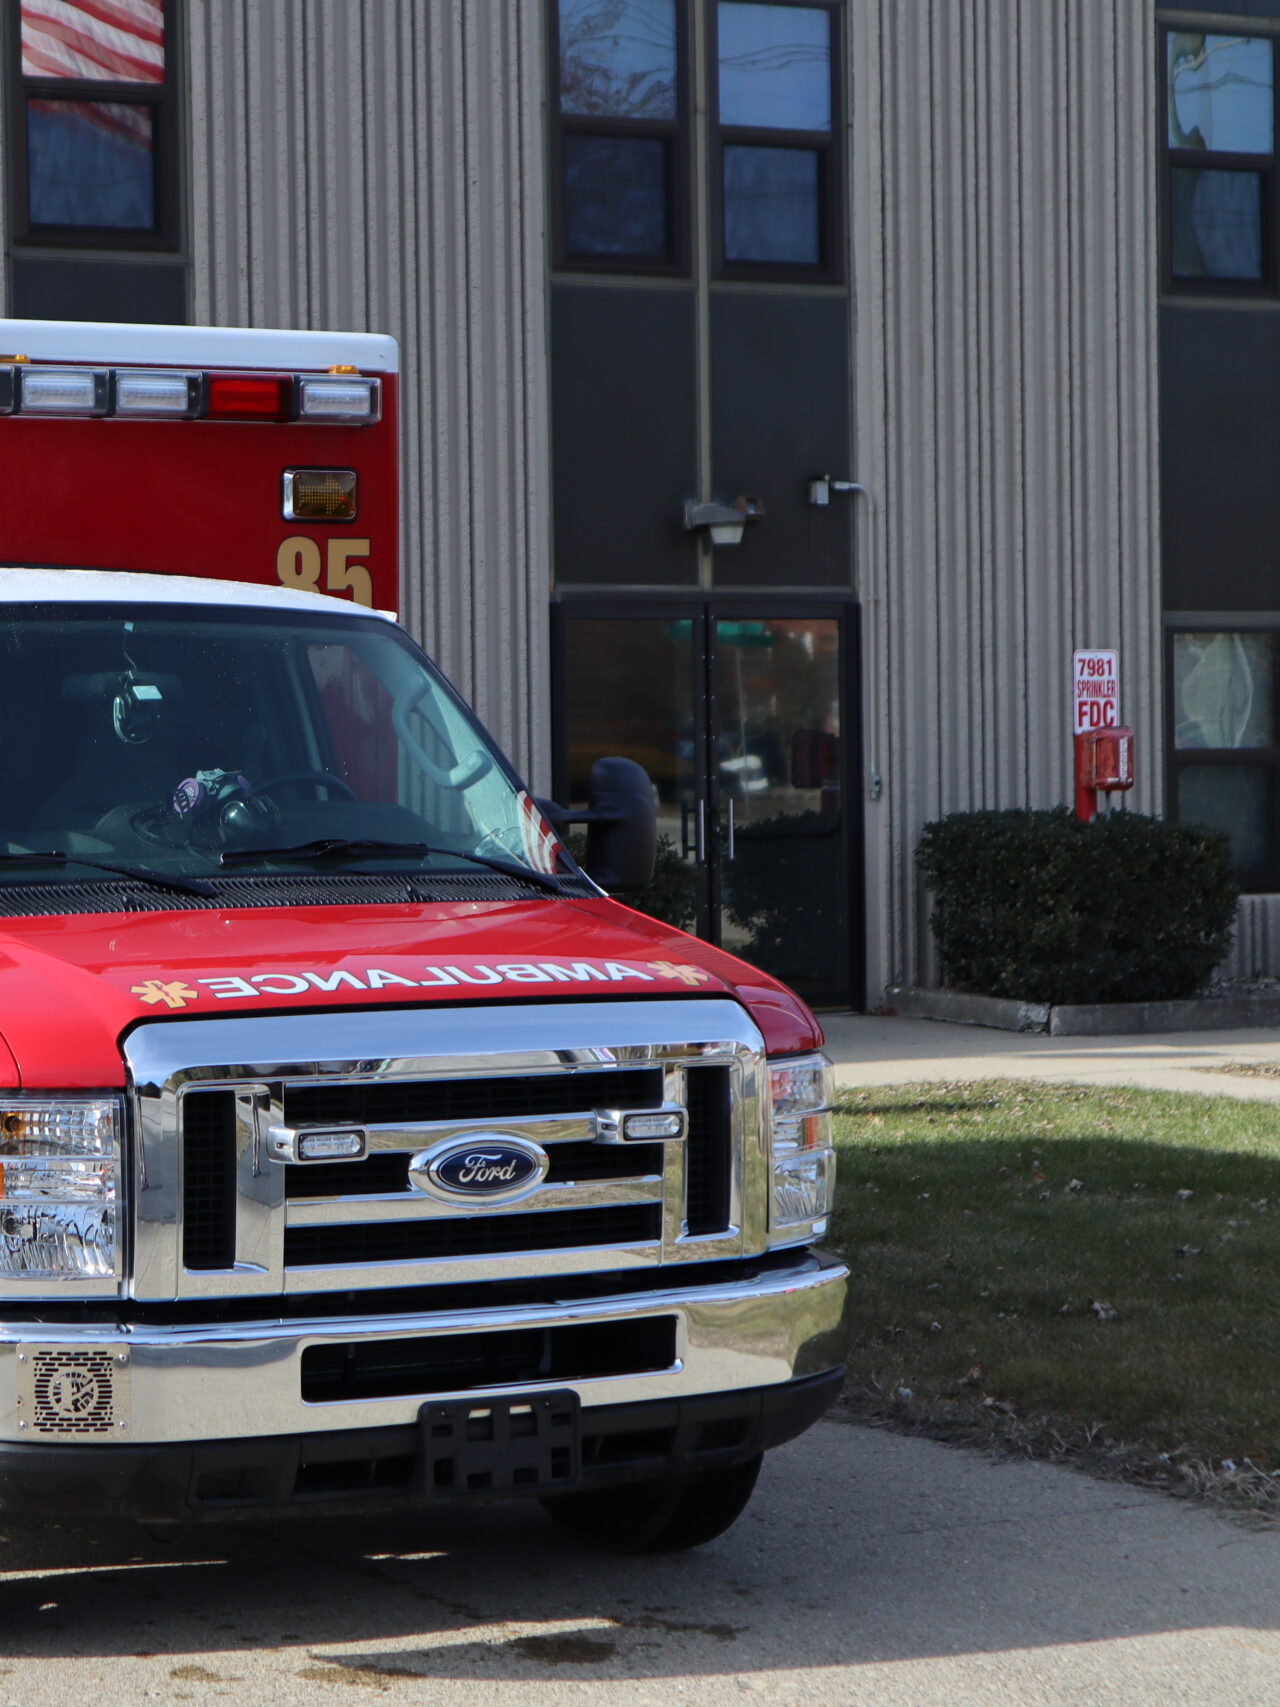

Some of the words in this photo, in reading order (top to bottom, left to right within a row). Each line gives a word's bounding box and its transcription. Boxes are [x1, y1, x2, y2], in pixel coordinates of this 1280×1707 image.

[1077, 657, 1113, 677] 7981
[1076, 679, 1117, 699] SPRINKLER
[1077, 700, 1115, 728] FDC
[458, 1153, 517, 1183] Ford
